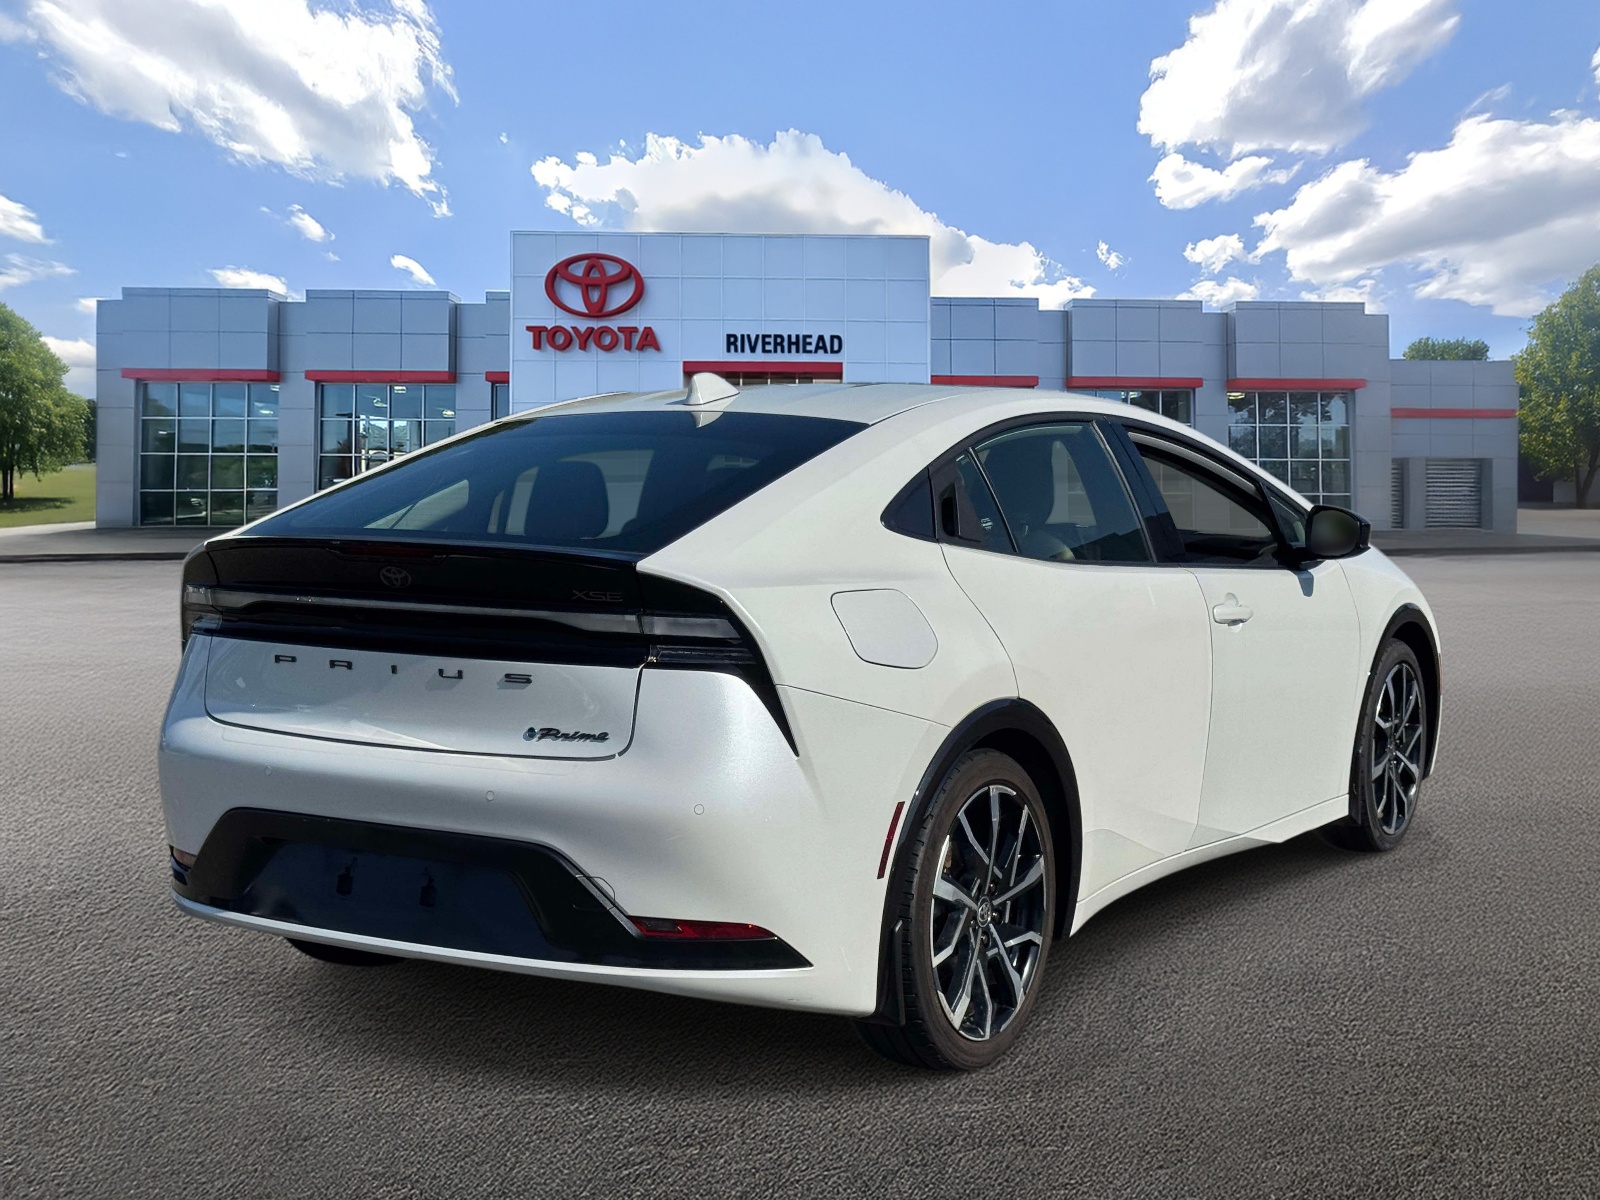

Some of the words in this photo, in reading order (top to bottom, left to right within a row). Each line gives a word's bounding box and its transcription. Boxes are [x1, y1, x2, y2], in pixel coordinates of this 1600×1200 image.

[525, 325, 661, 352] TOYOTA
[726, 333, 843, 354] RIVERHEAD
[571, 590, 623, 602] XSE
[274, 654, 533, 684] PRIUS
[537, 727, 609, 741] Prime
